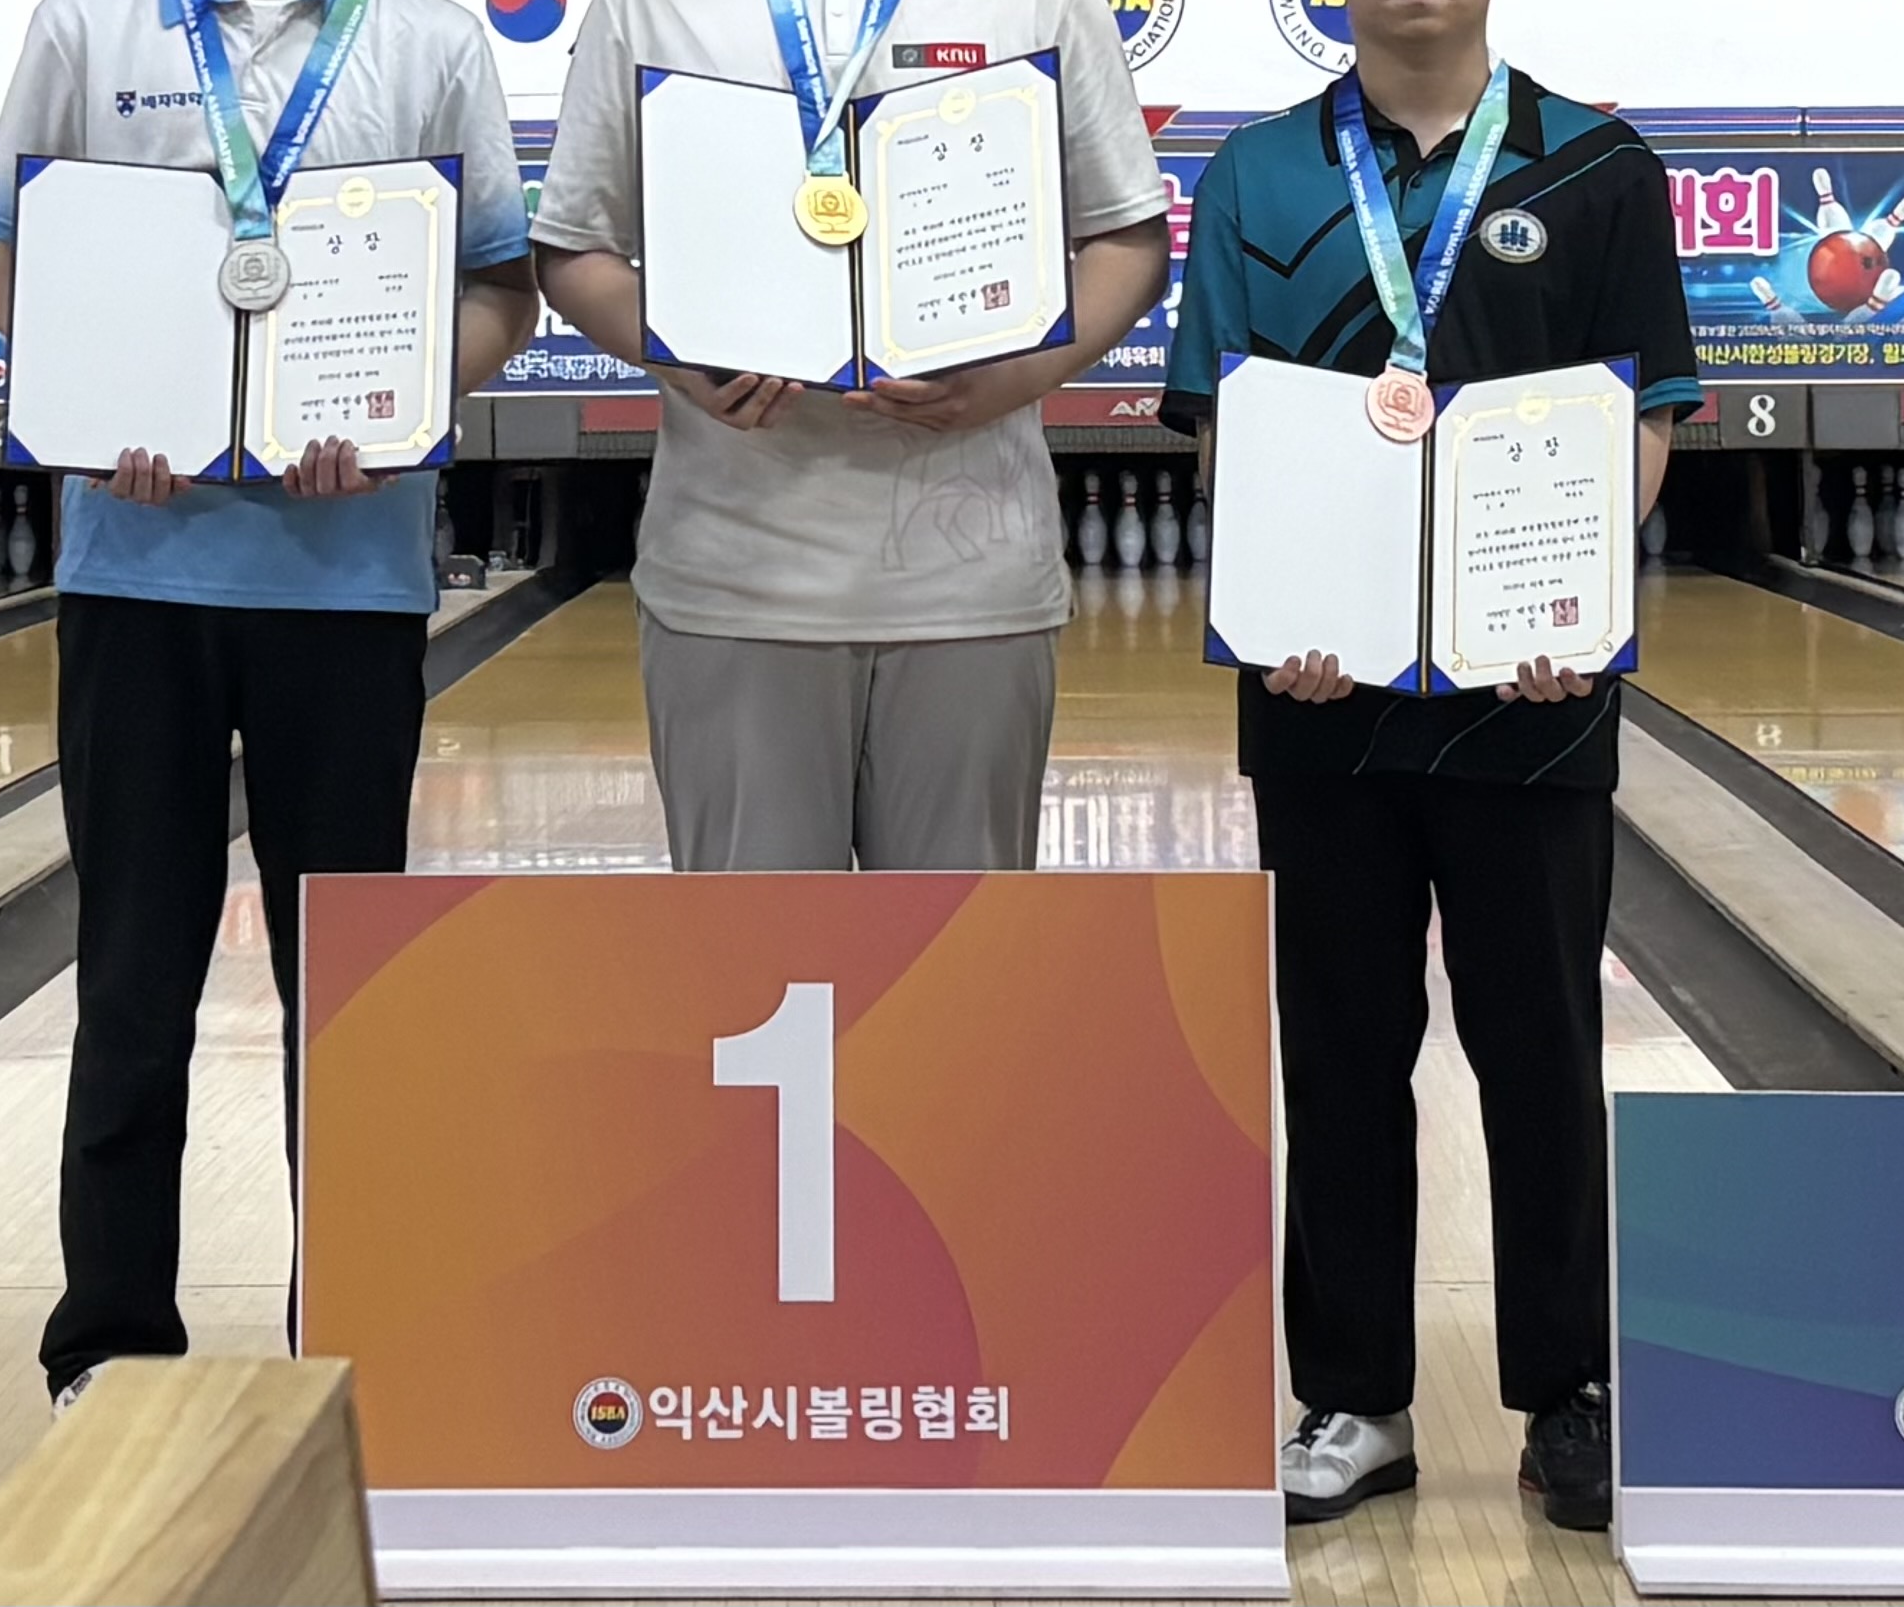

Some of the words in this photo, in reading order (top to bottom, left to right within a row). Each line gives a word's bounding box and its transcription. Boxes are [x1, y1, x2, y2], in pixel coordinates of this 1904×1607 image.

[1110, 397, 1160, 416] AM
[1747, 394, 1776, 437] 8
[713, 982, 835, 1303] 1
[647, 1384, 1011, 1441] 익산시볼링협회
